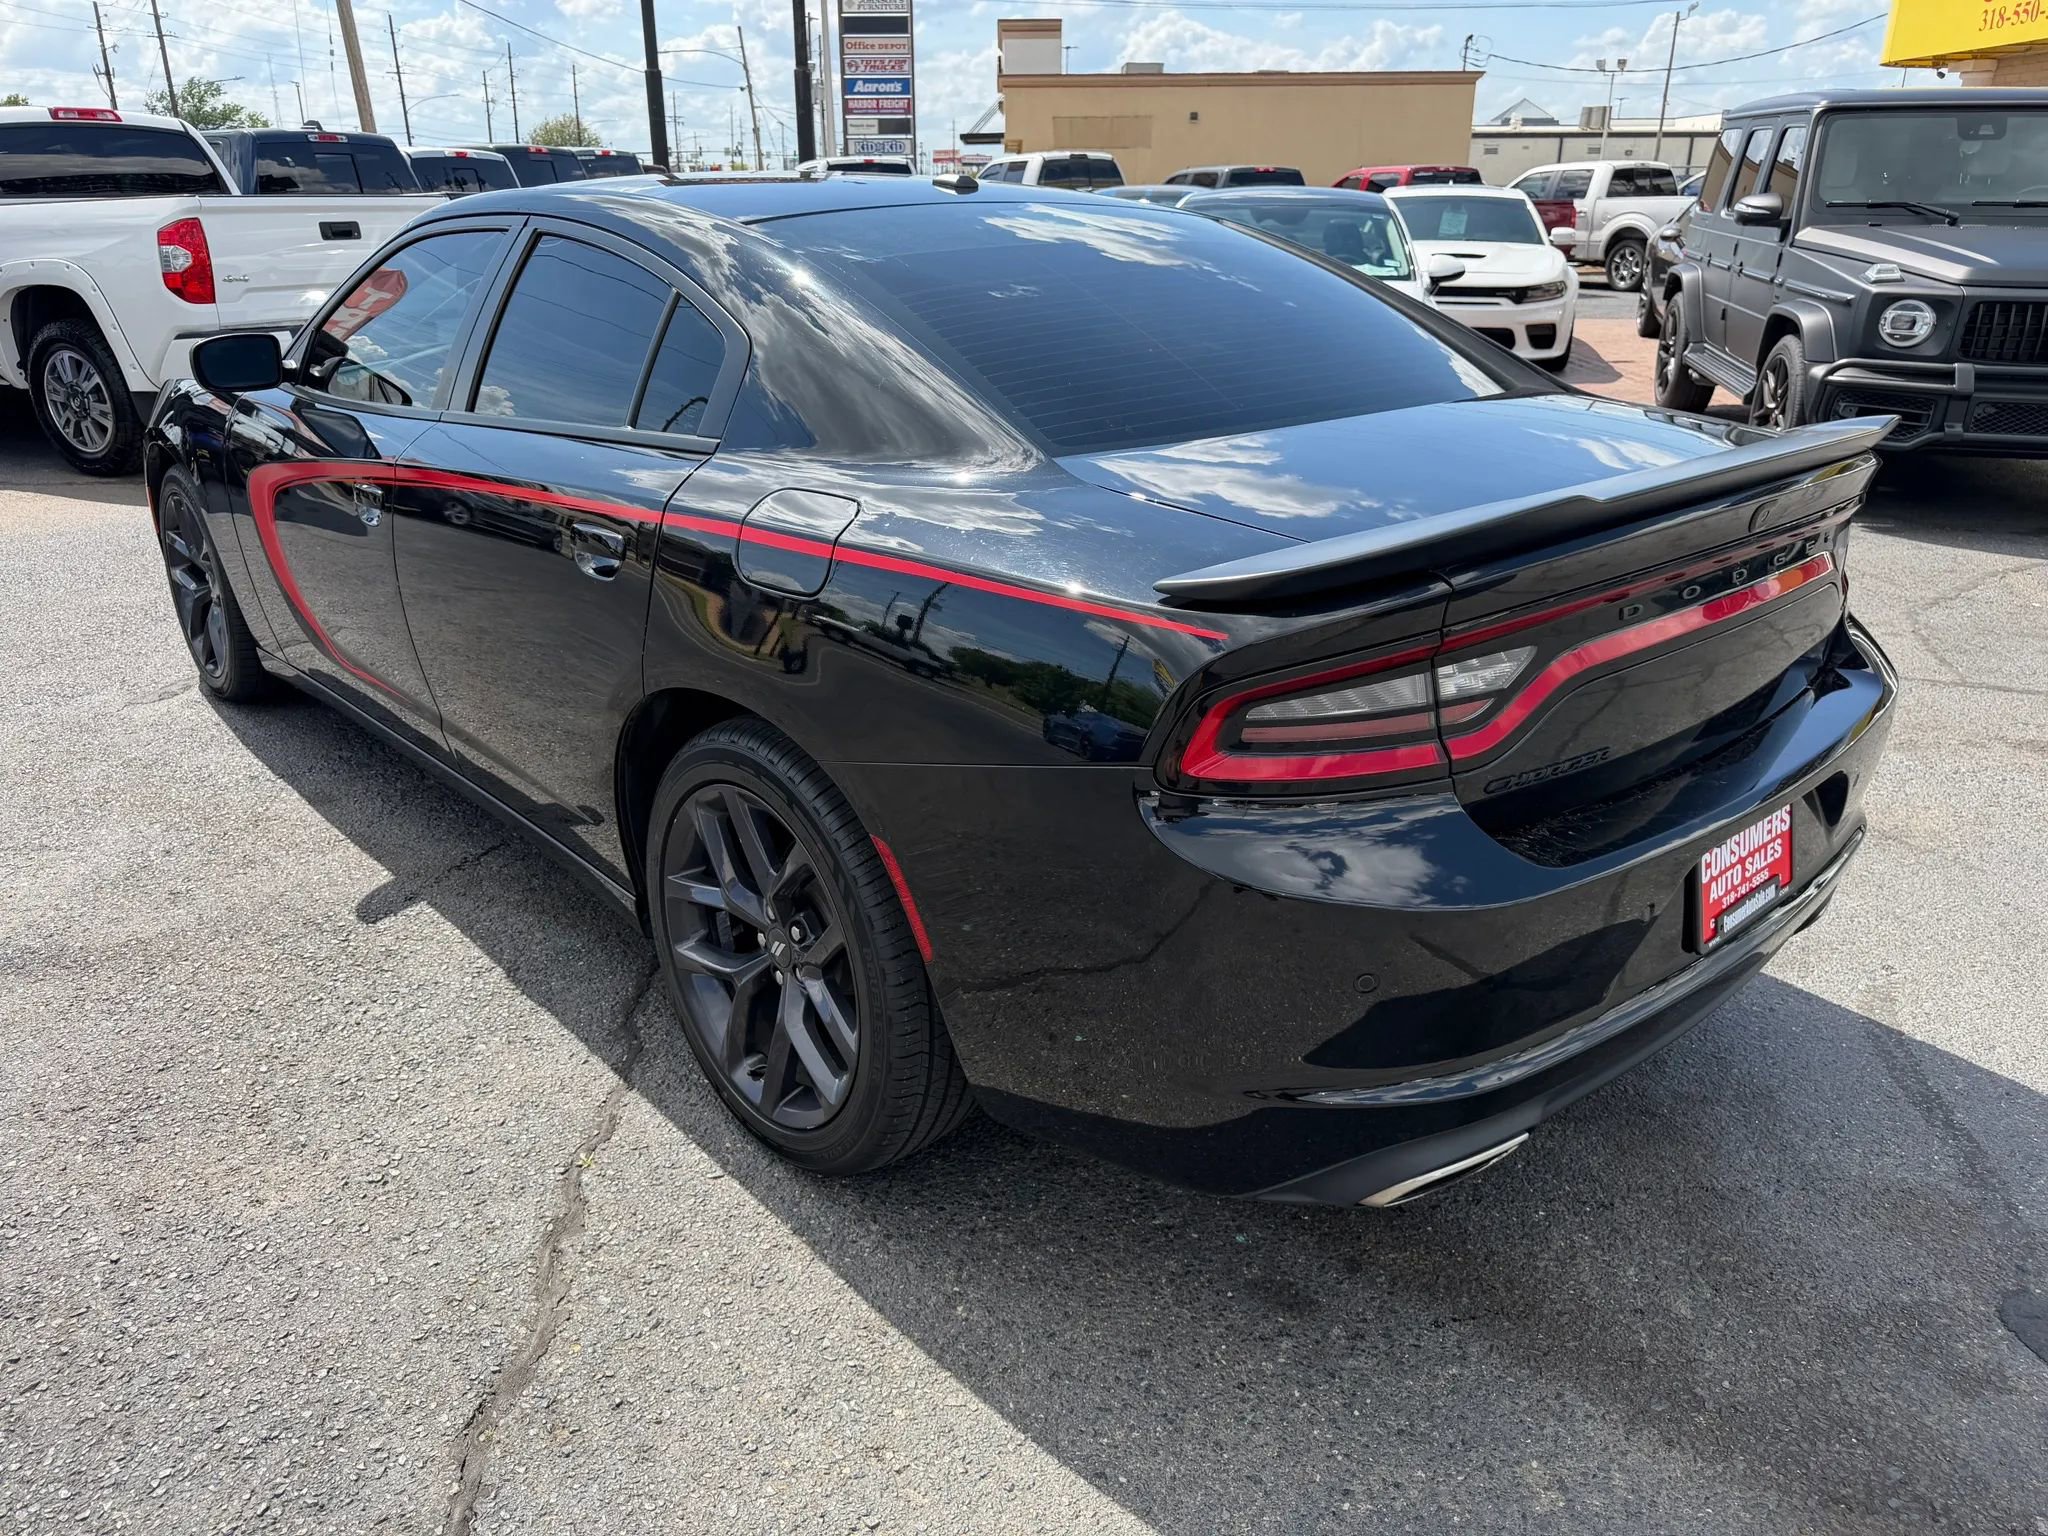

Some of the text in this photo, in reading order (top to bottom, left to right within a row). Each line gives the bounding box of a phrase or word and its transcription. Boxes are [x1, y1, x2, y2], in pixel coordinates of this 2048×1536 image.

[857, 3, 907, 11] FURNITURE
[845, 41, 907, 50] Office DEPOT
[853, 79, 903, 93] Aaron's
[848, 99, 909, 109] HARBOR FREIGHT
[1618, 540, 1817, 620] DODGE
[1701, 803, 1791, 884] CONSUMERS
[1709, 838, 1782, 904] AUTO SALES
[1721, 868, 1769, 909] 318-741-5555
